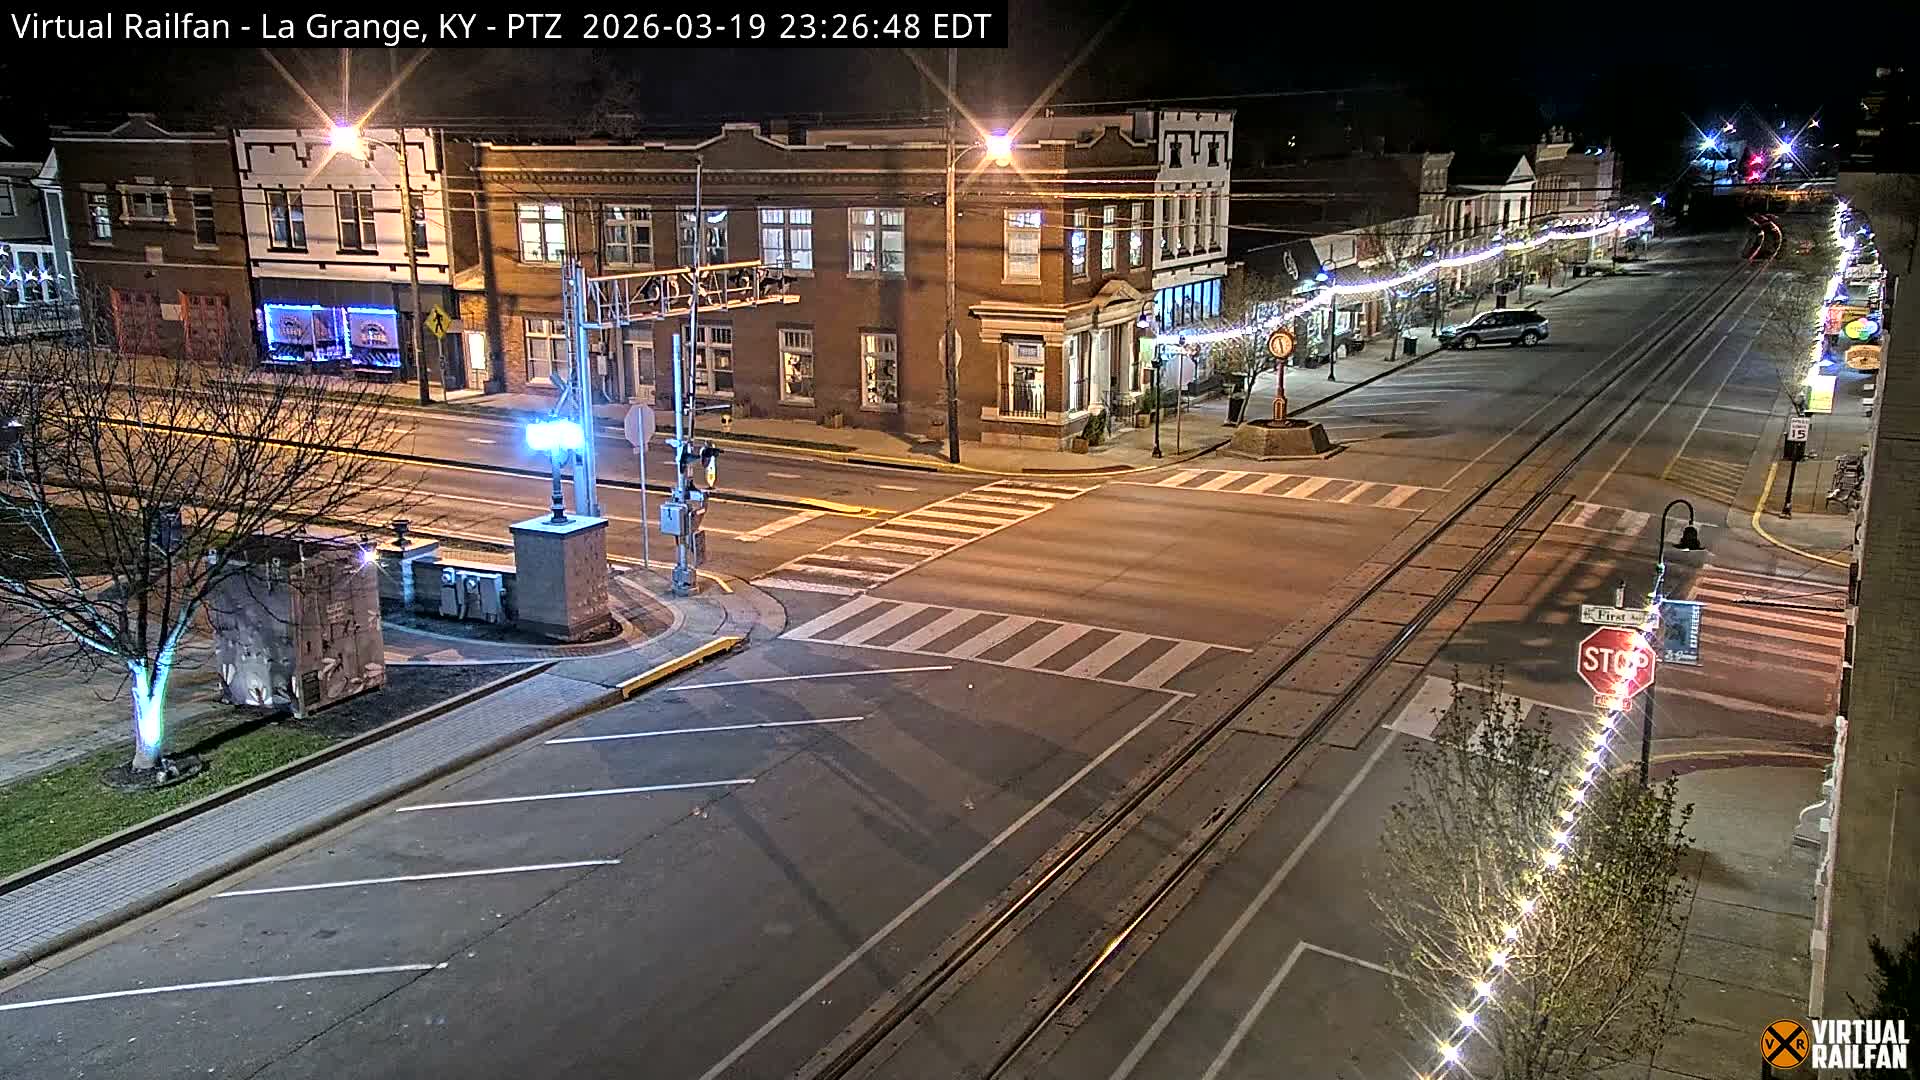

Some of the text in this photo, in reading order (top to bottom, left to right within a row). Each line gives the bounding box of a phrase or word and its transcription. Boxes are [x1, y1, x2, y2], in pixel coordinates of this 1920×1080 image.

[1792, 429, 1806, 439] 15
[1598, 609, 1626, 621] First
[1583, 646, 1649, 675] STOP
